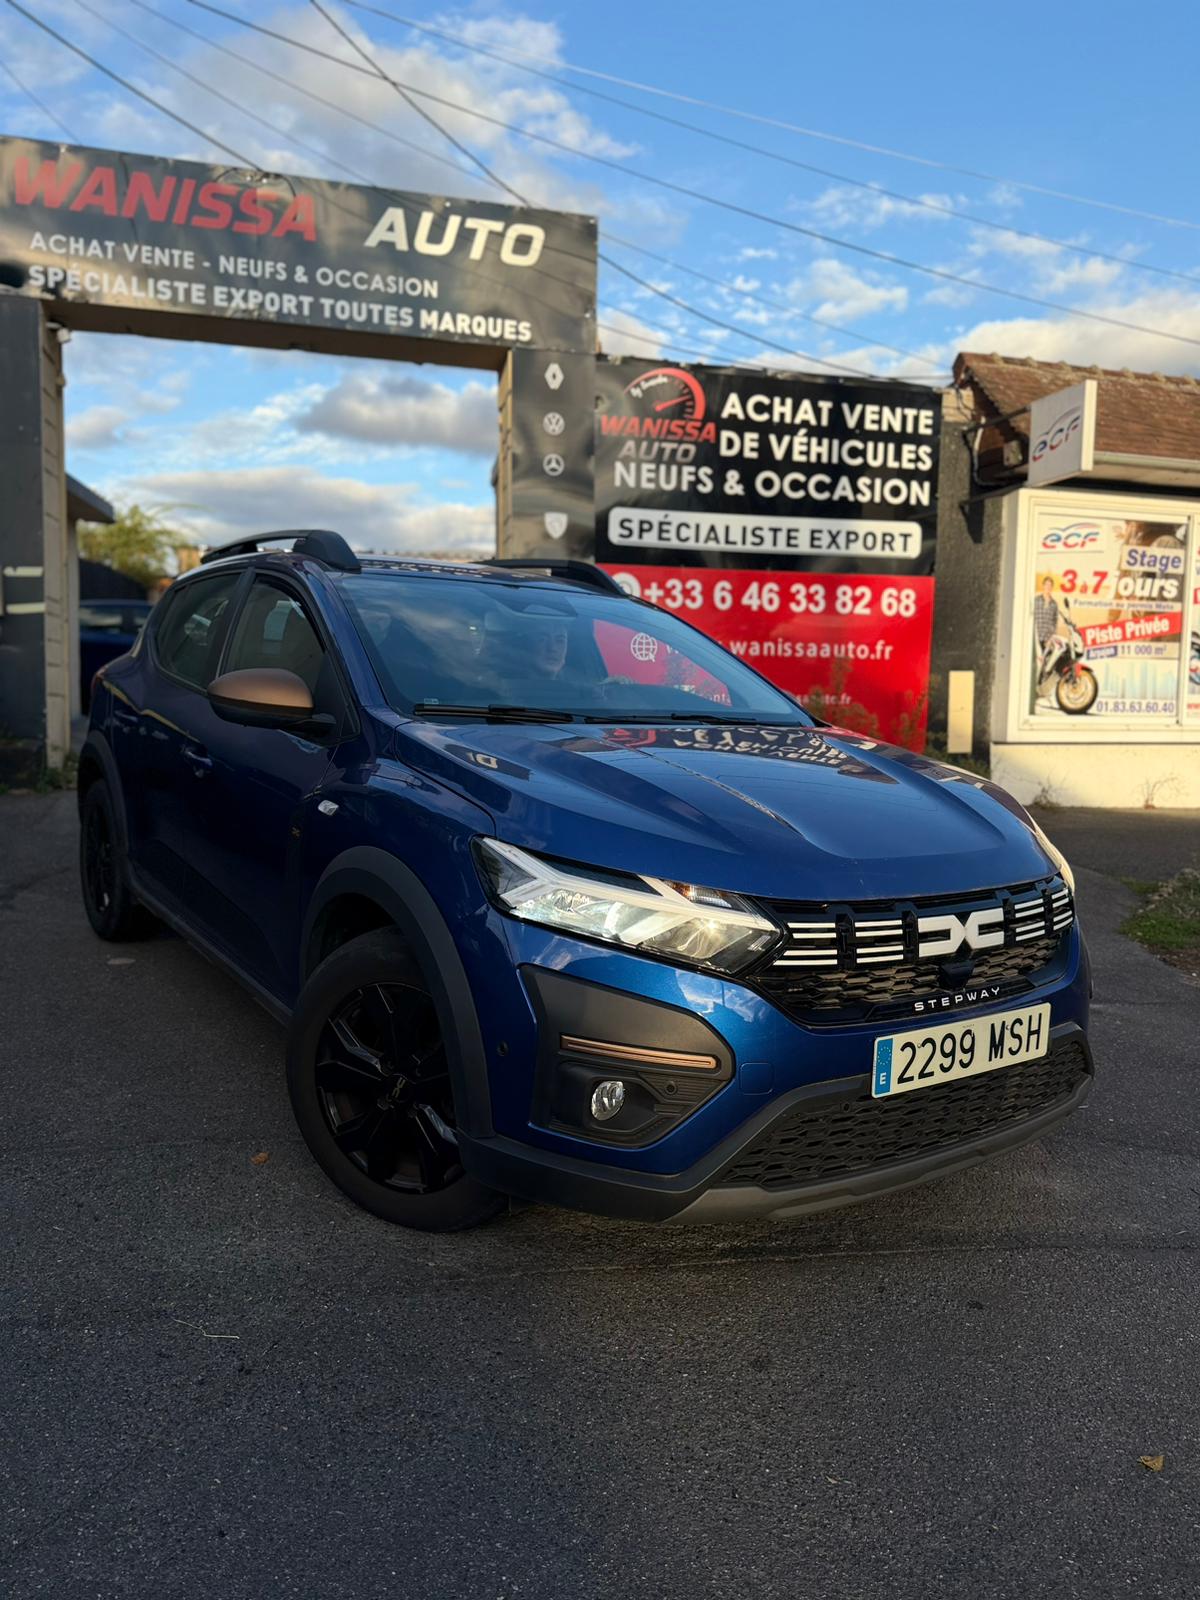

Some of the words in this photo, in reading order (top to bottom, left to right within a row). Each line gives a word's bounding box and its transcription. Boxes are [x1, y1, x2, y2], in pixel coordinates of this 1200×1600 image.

[14, 156, 317, 242] WANISSA
[364, 206, 546, 268] AUTO
[30, 231, 116, 260] ACHAT
[123, 243, 195, 270] VENTE
[218, 255, 287, 281] NEUFS
[294, 265, 309, 284] &
[315, 267, 439, 299] OCCASION
[28, 263, 206, 305] SPÉCIALISTE
[213, 286, 314, 316] EXPORT
[320, 298, 414, 328] TOUTES
[420, 309, 532, 343] MARQUES
[601, 415, 717, 443] WANISSA
[721, 393, 833, 428] ACHAT
[842, 402, 934, 435] VENTE
[618, 440, 697, 463] AUTO
[719, 430, 759, 459] DE
[769, 429, 933, 471] VÉHICULES
[614, 462, 714, 494] NEUFS
[724, 469, 745, 496] &
[754, 471, 931, 506] OCCASION
[618, 514, 800, 548] SPÉCIALISTE
[810, 530, 913, 552] EXPORT
[1126, 549, 1181, 573] Stage
[644, 578, 704, 610] +33
[713, 580, 733, 610] 6
[741, 582, 780, 612] 46
[789, 584, 827, 613] 33
[835, 586, 871, 615] 82
[881, 588, 917, 617] 68
[1060, 569, 1078, 594] 3
[1092, 571, 1108, 595] 7
[718, 638, 893, 661] wanissaauto.fr
[1085, 624, 1122, 647] Piste
[1125, 616, 1170, 640] Privée
[914, 987, 1000, 1011] STEPWAY
[879, 1072, 886, 1085] E
[897, 1029, 975, 1084] 2299
[988, 1013, 1042, 1062] MSH
